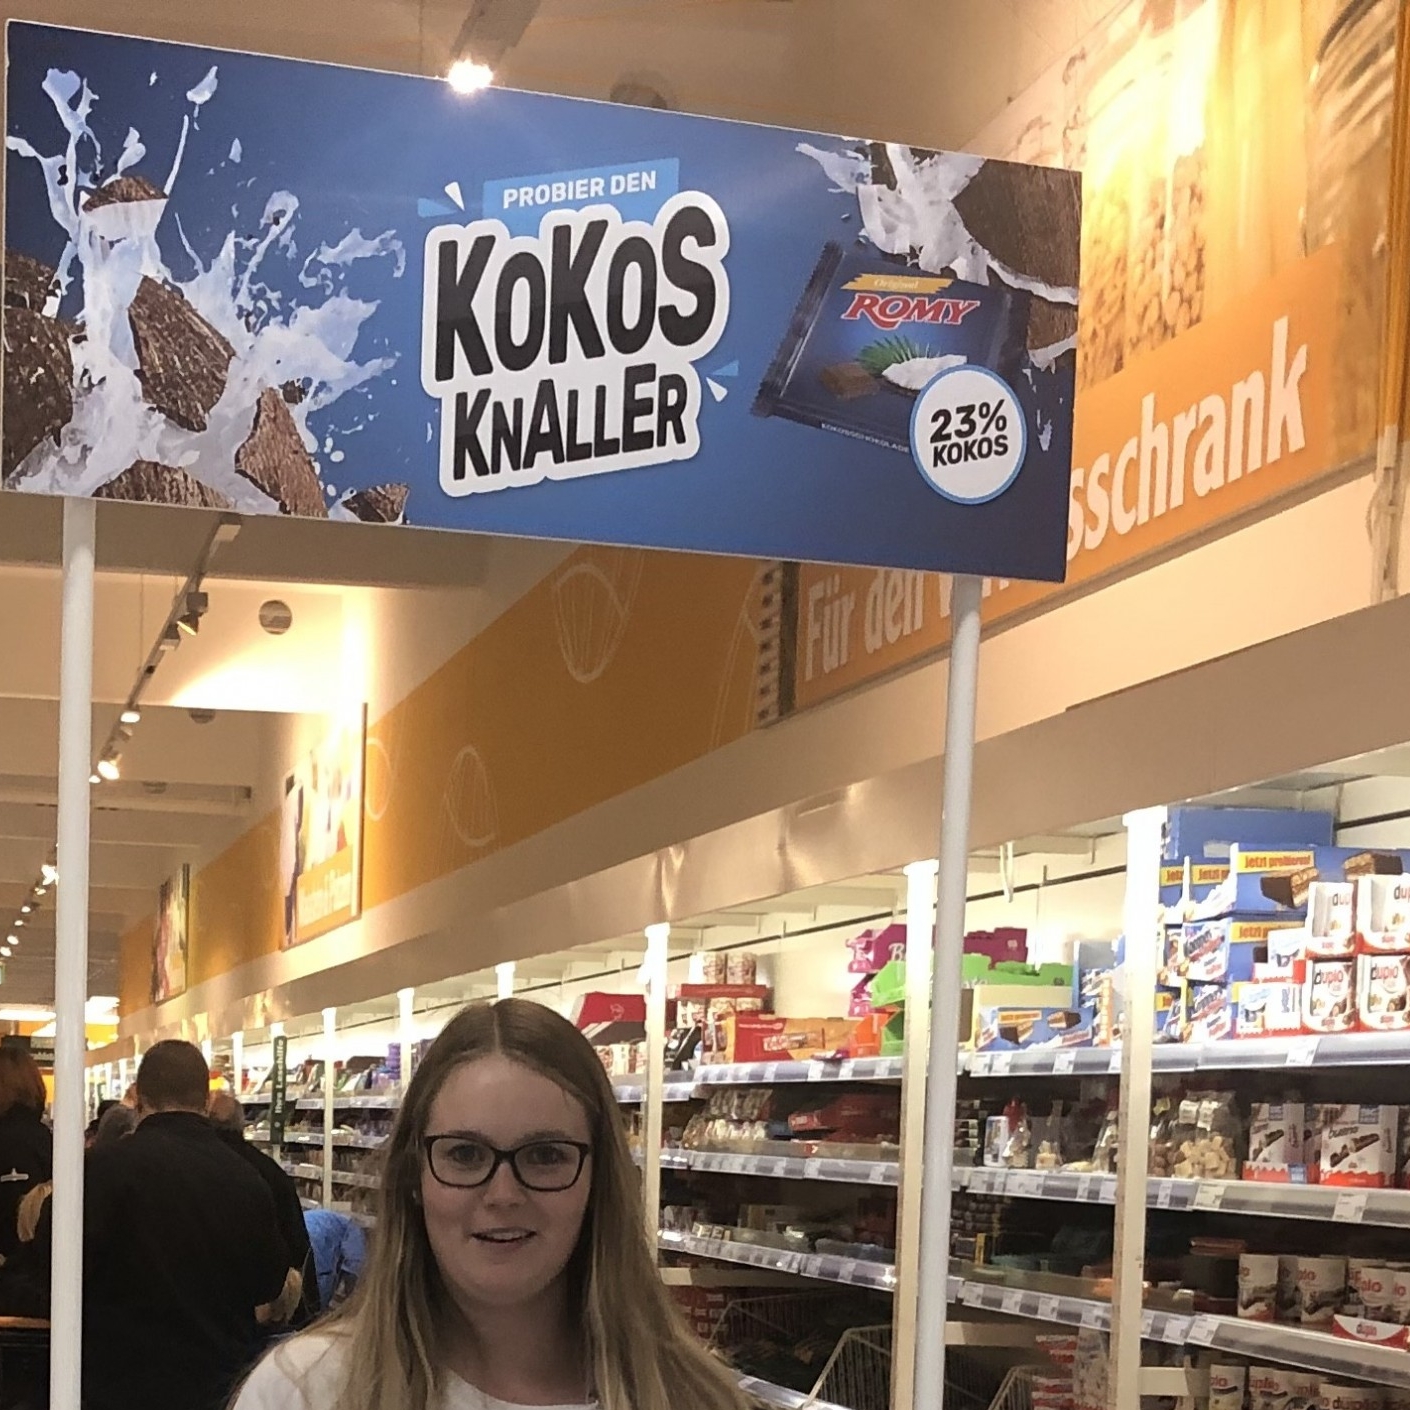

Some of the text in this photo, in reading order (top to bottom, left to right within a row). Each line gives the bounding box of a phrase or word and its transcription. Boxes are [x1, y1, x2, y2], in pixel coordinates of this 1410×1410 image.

[503, 170, 657, 209] PROBIER DEN
[435, 206, 717, 382] KOKOS
[841, 293, 981, 331] ROMY
[453, 363, 688, 481] KNALLER
[929, 398, 1008, 444] 23%
[932, 434, 1009, 468] KOKOS
[804, 574, 856, 682] Für
